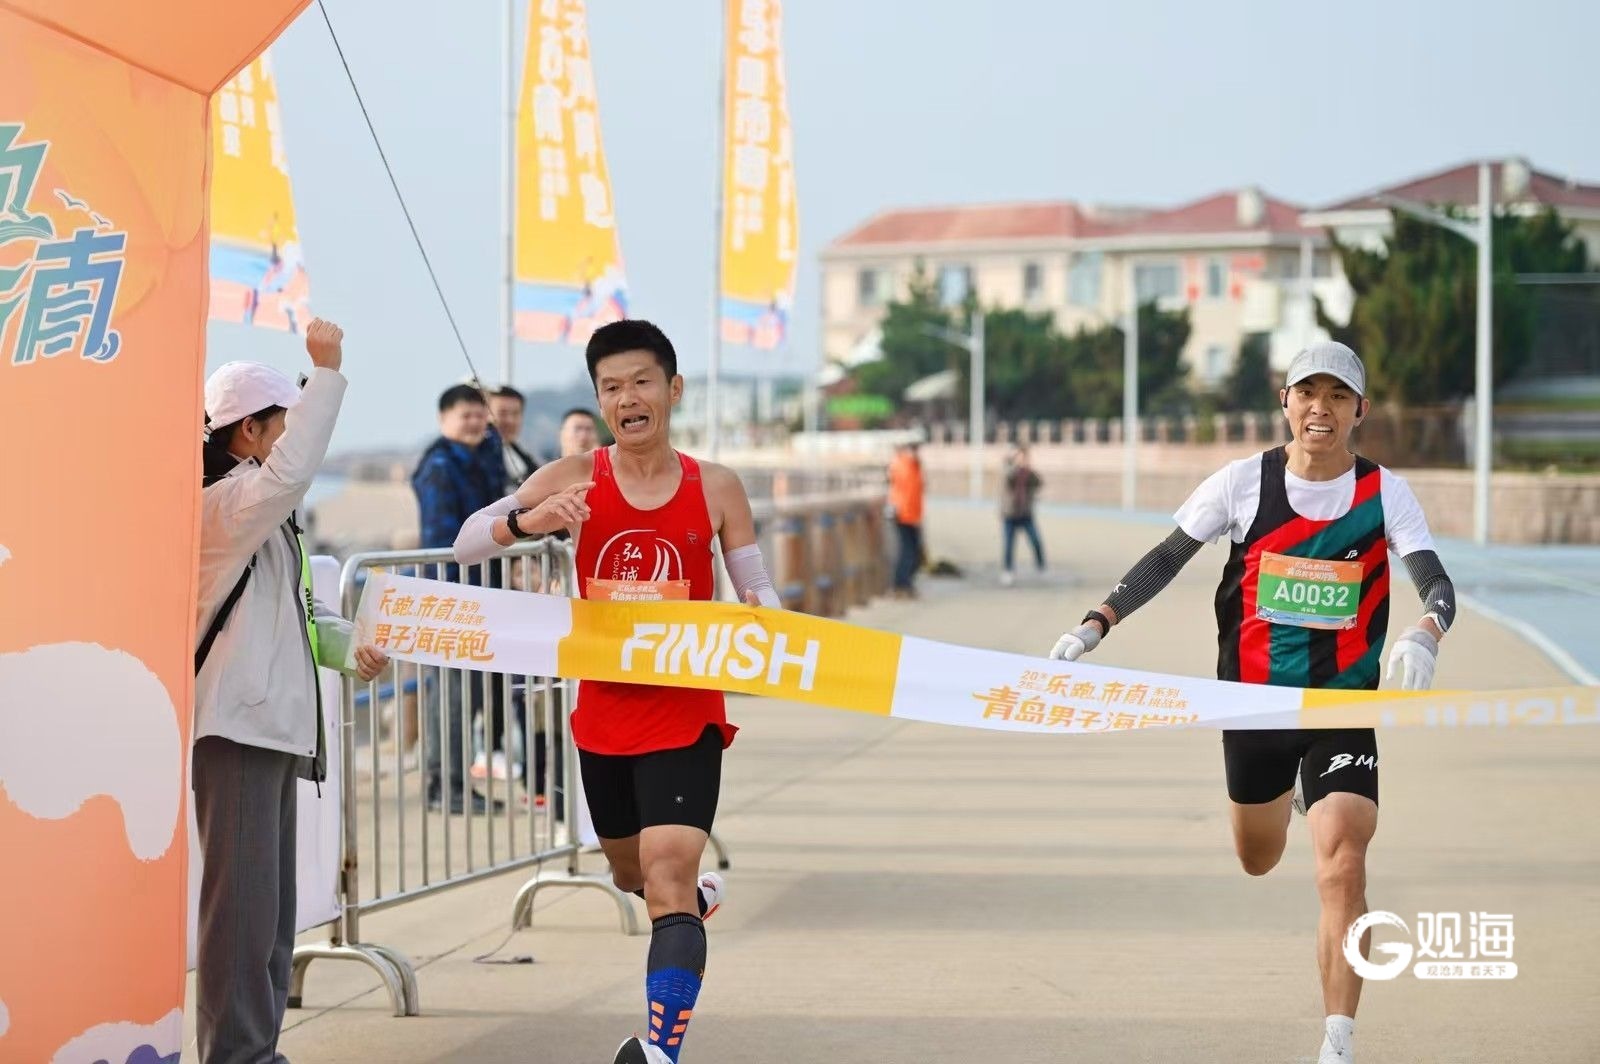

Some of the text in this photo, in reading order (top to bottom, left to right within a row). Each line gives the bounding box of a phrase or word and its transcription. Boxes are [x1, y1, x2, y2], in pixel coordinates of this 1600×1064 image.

[1273, 579, 1350, 608] A0032
[374, 622, 495, 662] 男子海岸跑
[620, 622, 821, 692] FINISH
